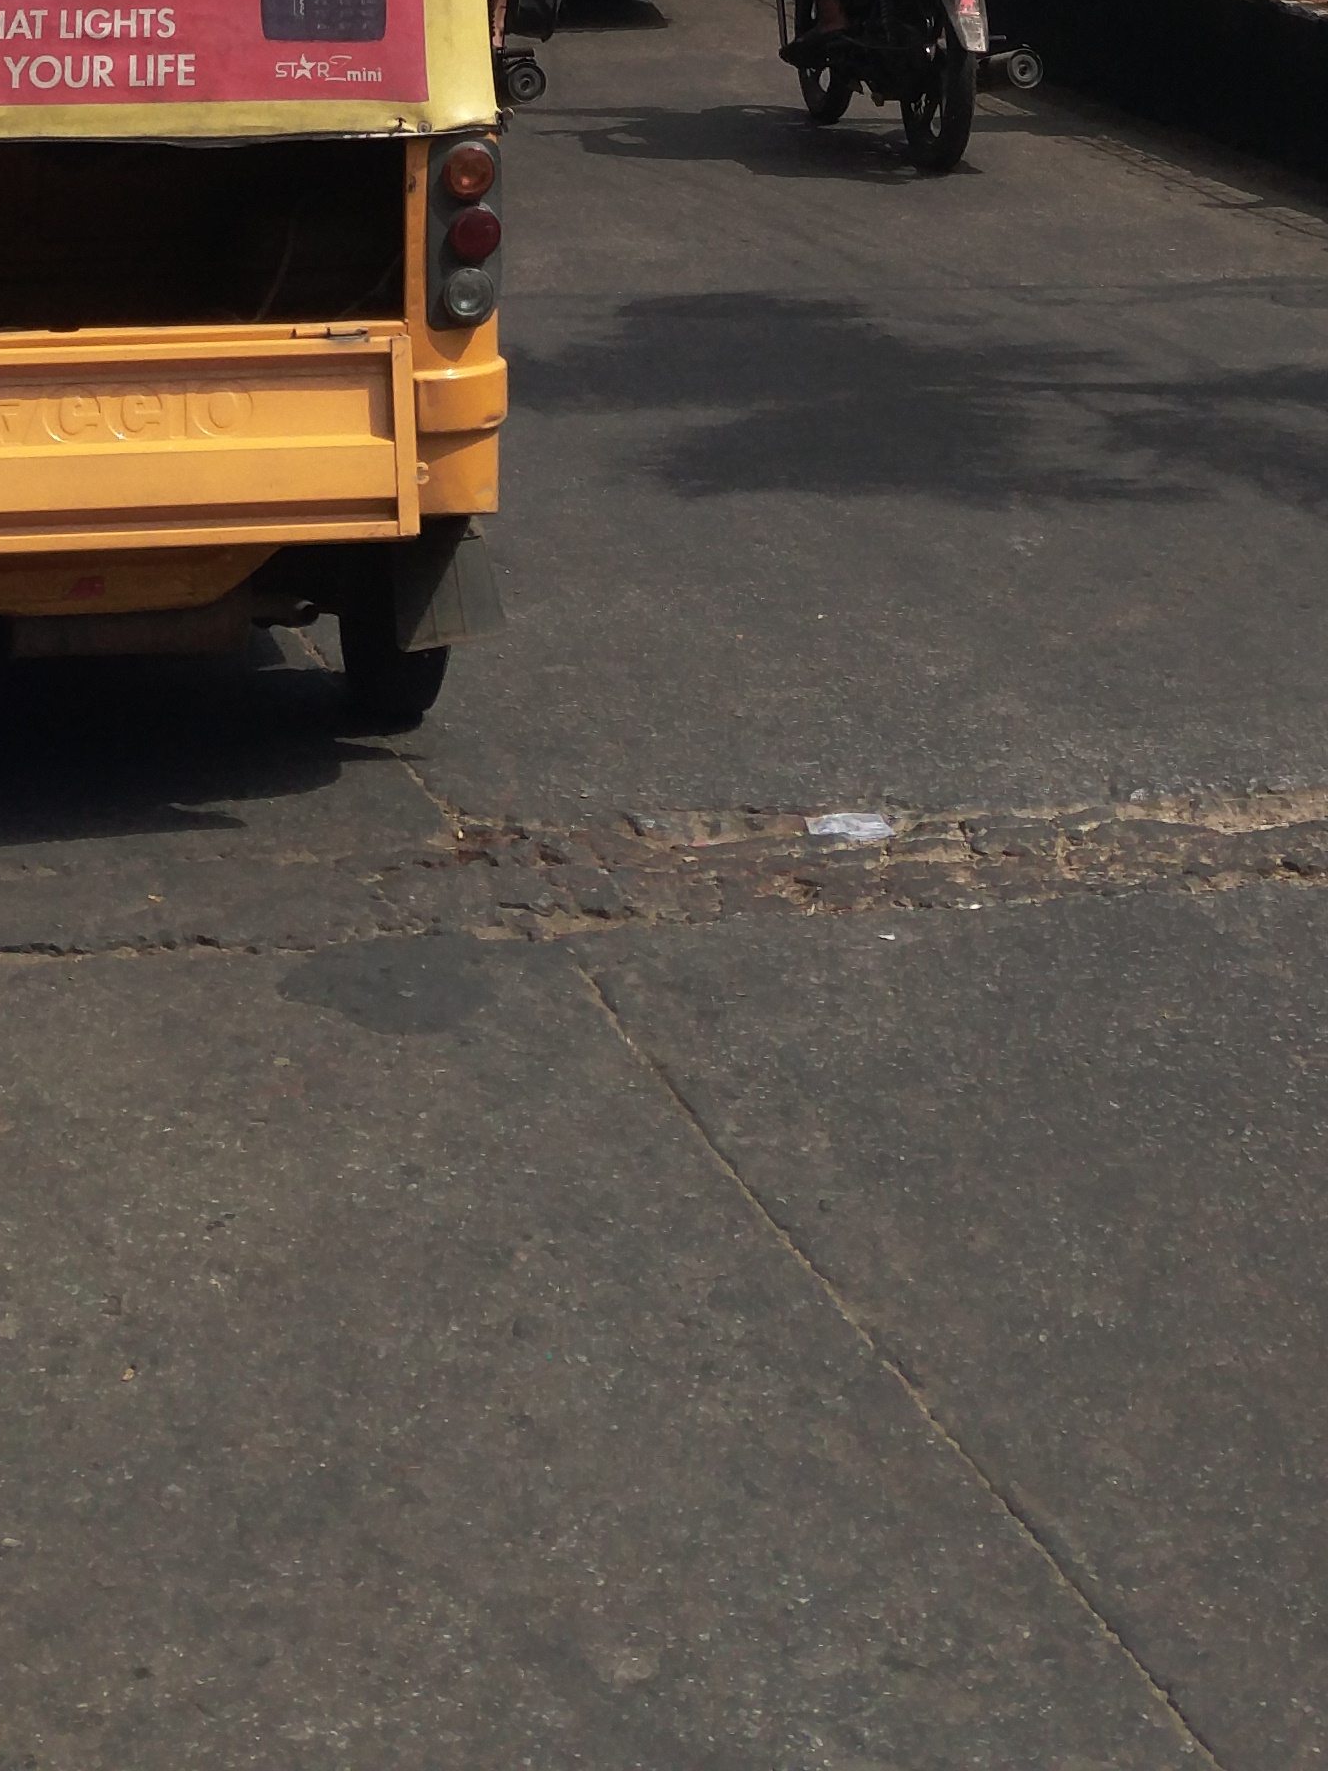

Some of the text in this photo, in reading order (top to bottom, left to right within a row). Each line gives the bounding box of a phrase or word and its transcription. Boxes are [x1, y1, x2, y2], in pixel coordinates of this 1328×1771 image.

[60, 8, 176, 39] LIGHTS
[3, 55, 115, 89] YOUR
[129, 54, 196, 87] LIFE
[346, 67, 382, 82] mini
